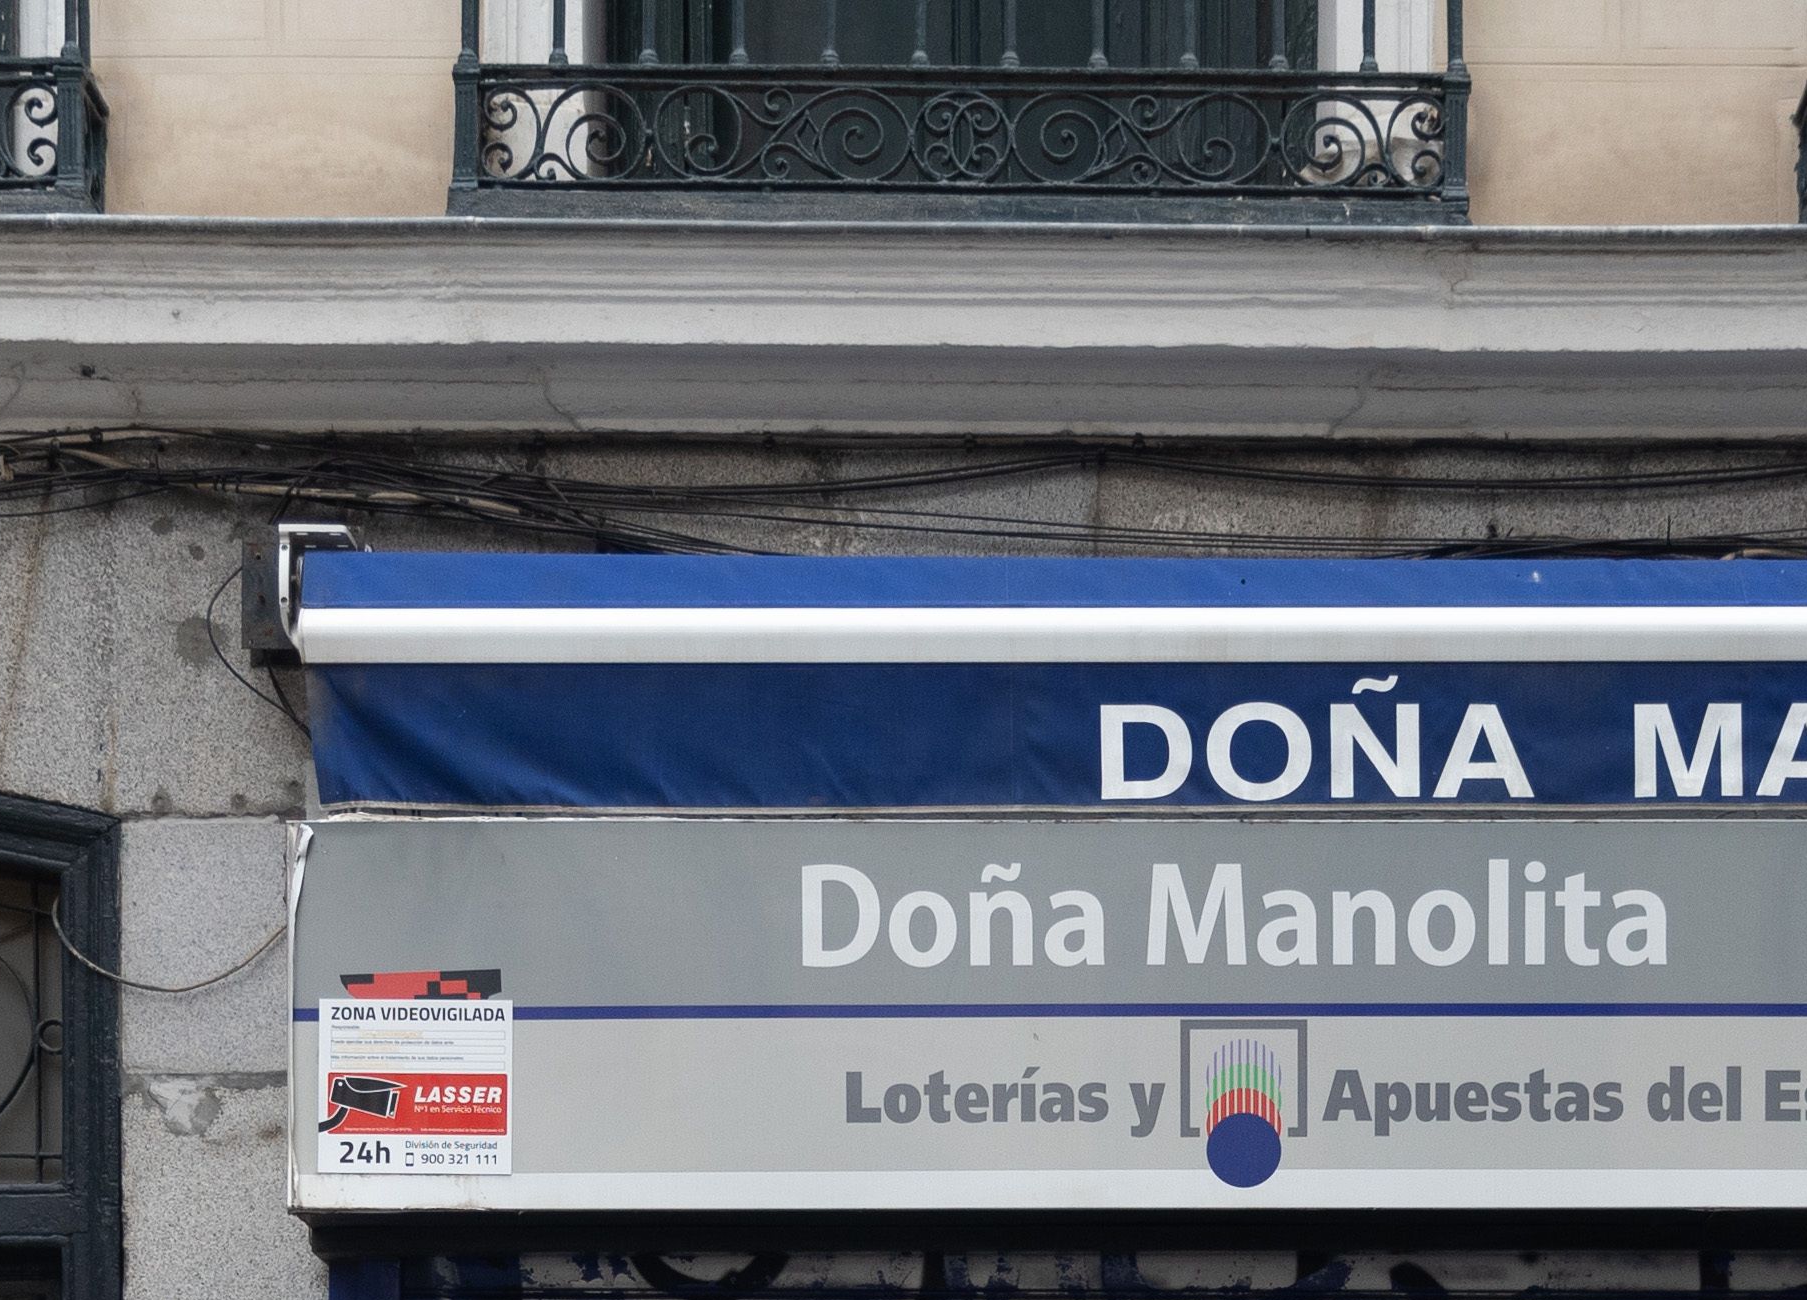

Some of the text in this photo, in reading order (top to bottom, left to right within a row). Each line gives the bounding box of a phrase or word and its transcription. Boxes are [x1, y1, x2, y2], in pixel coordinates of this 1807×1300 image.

[1099, 674, 1534, 801] DOÑA
[799, 859, 1669, 969] Doña Manolita
[331, 1006, 505, 1022] ZONA VIDEOVIGILADA
[414, 1086, 502, 1104] LASSER
[844, 1065, 1110, 1125] Loterías
[1128, 1080, 1165, 1136] y
[1322, 1068, 1625, 1135] Apuestas
[1648, 1064, 1744, 1124] del
[442, 1105, 472, 1113] Servicio
[473, 1105, 502, 1113] Técnico
[339, 1141, 391, 1164] 24h
[405, 1140, 498, 1151] División de Seguridad
[421, 1154, 497, 1164] 900 321 111
